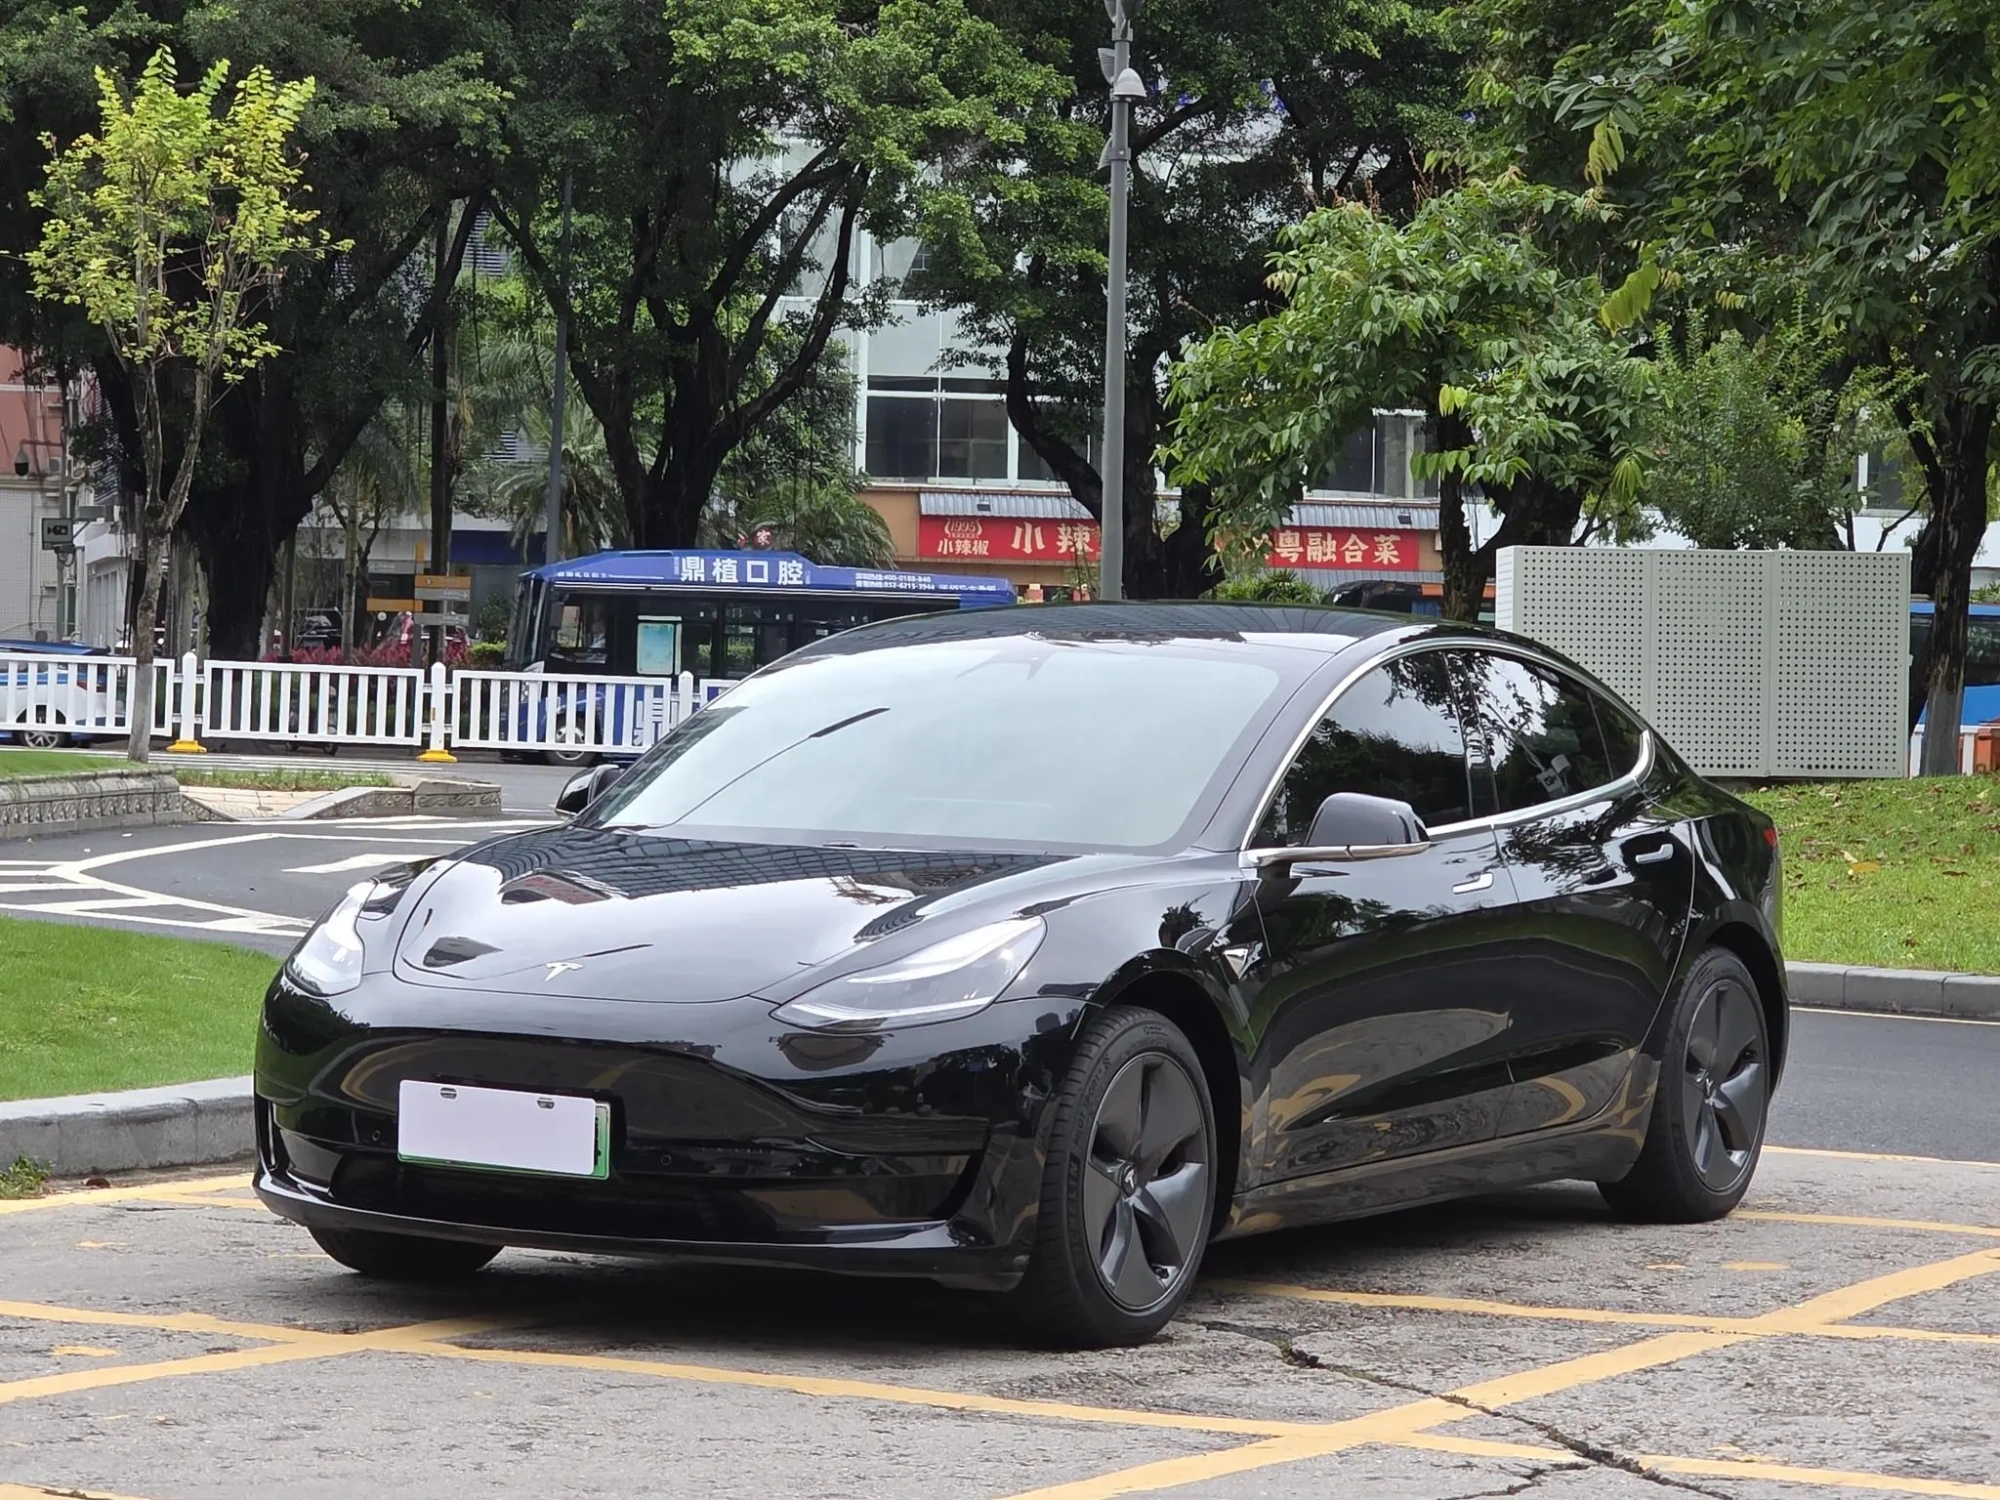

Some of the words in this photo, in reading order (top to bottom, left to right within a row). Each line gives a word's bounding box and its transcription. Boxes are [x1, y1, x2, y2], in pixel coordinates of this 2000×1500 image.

[950, 520, 977, 532] 1995
[1010, 521, 1101, 554] 小辣
[937, 538, 989, 555] 小辣椒
[680, 556, 804, 585] 鼎植口腔
